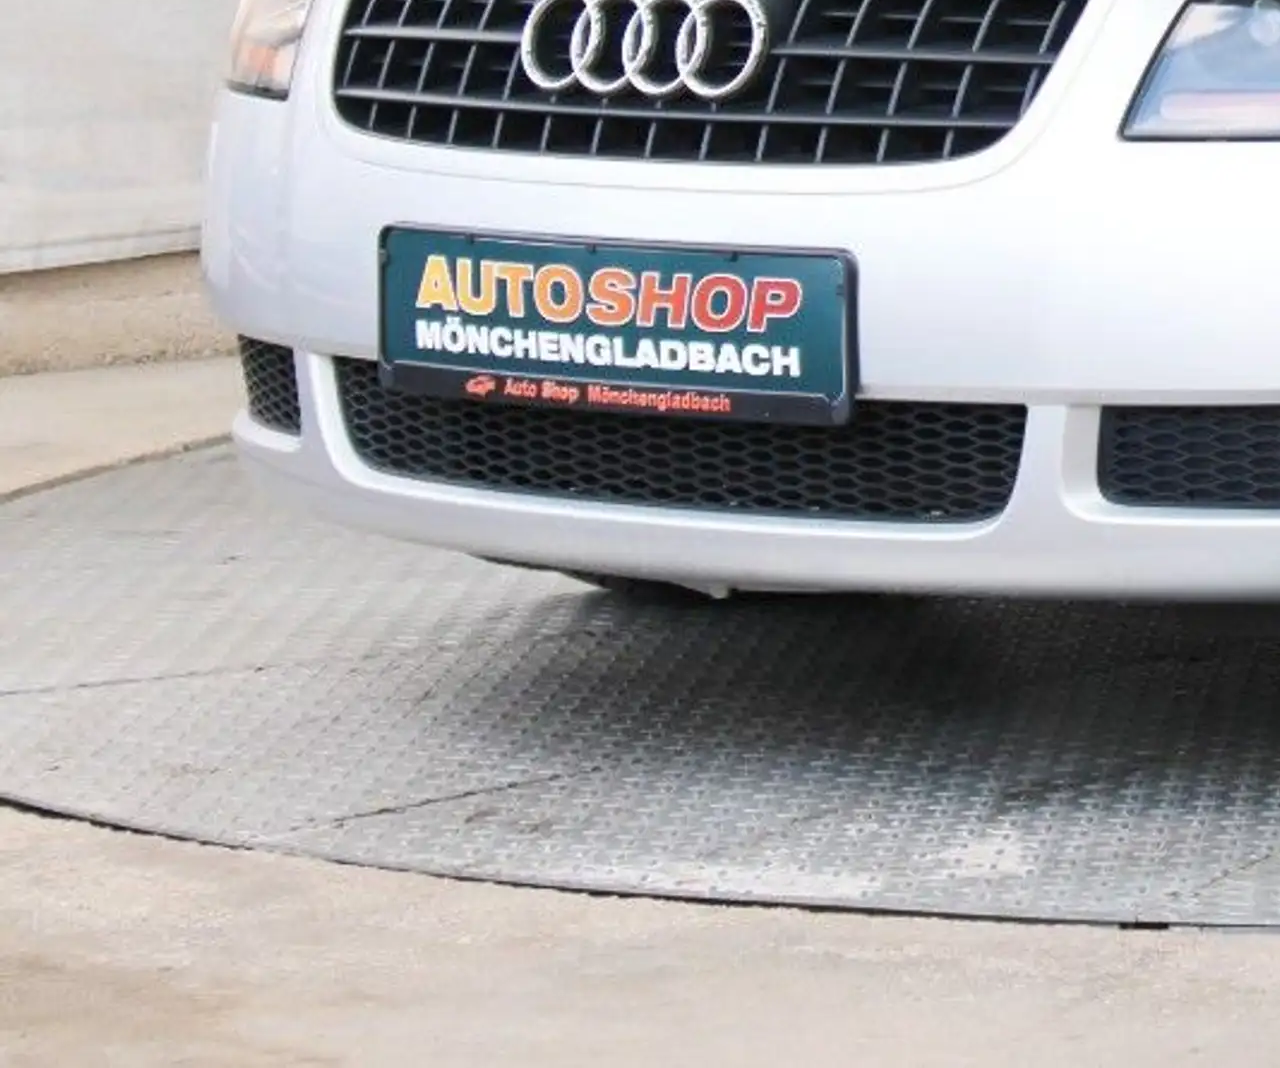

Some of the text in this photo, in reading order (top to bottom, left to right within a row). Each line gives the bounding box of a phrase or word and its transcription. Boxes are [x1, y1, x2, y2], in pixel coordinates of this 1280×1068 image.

[414, 318, 801, 378] MÖNCHENGLADBACH
[504, 376, 731, 412] Auto Shop Mönchengladbach
